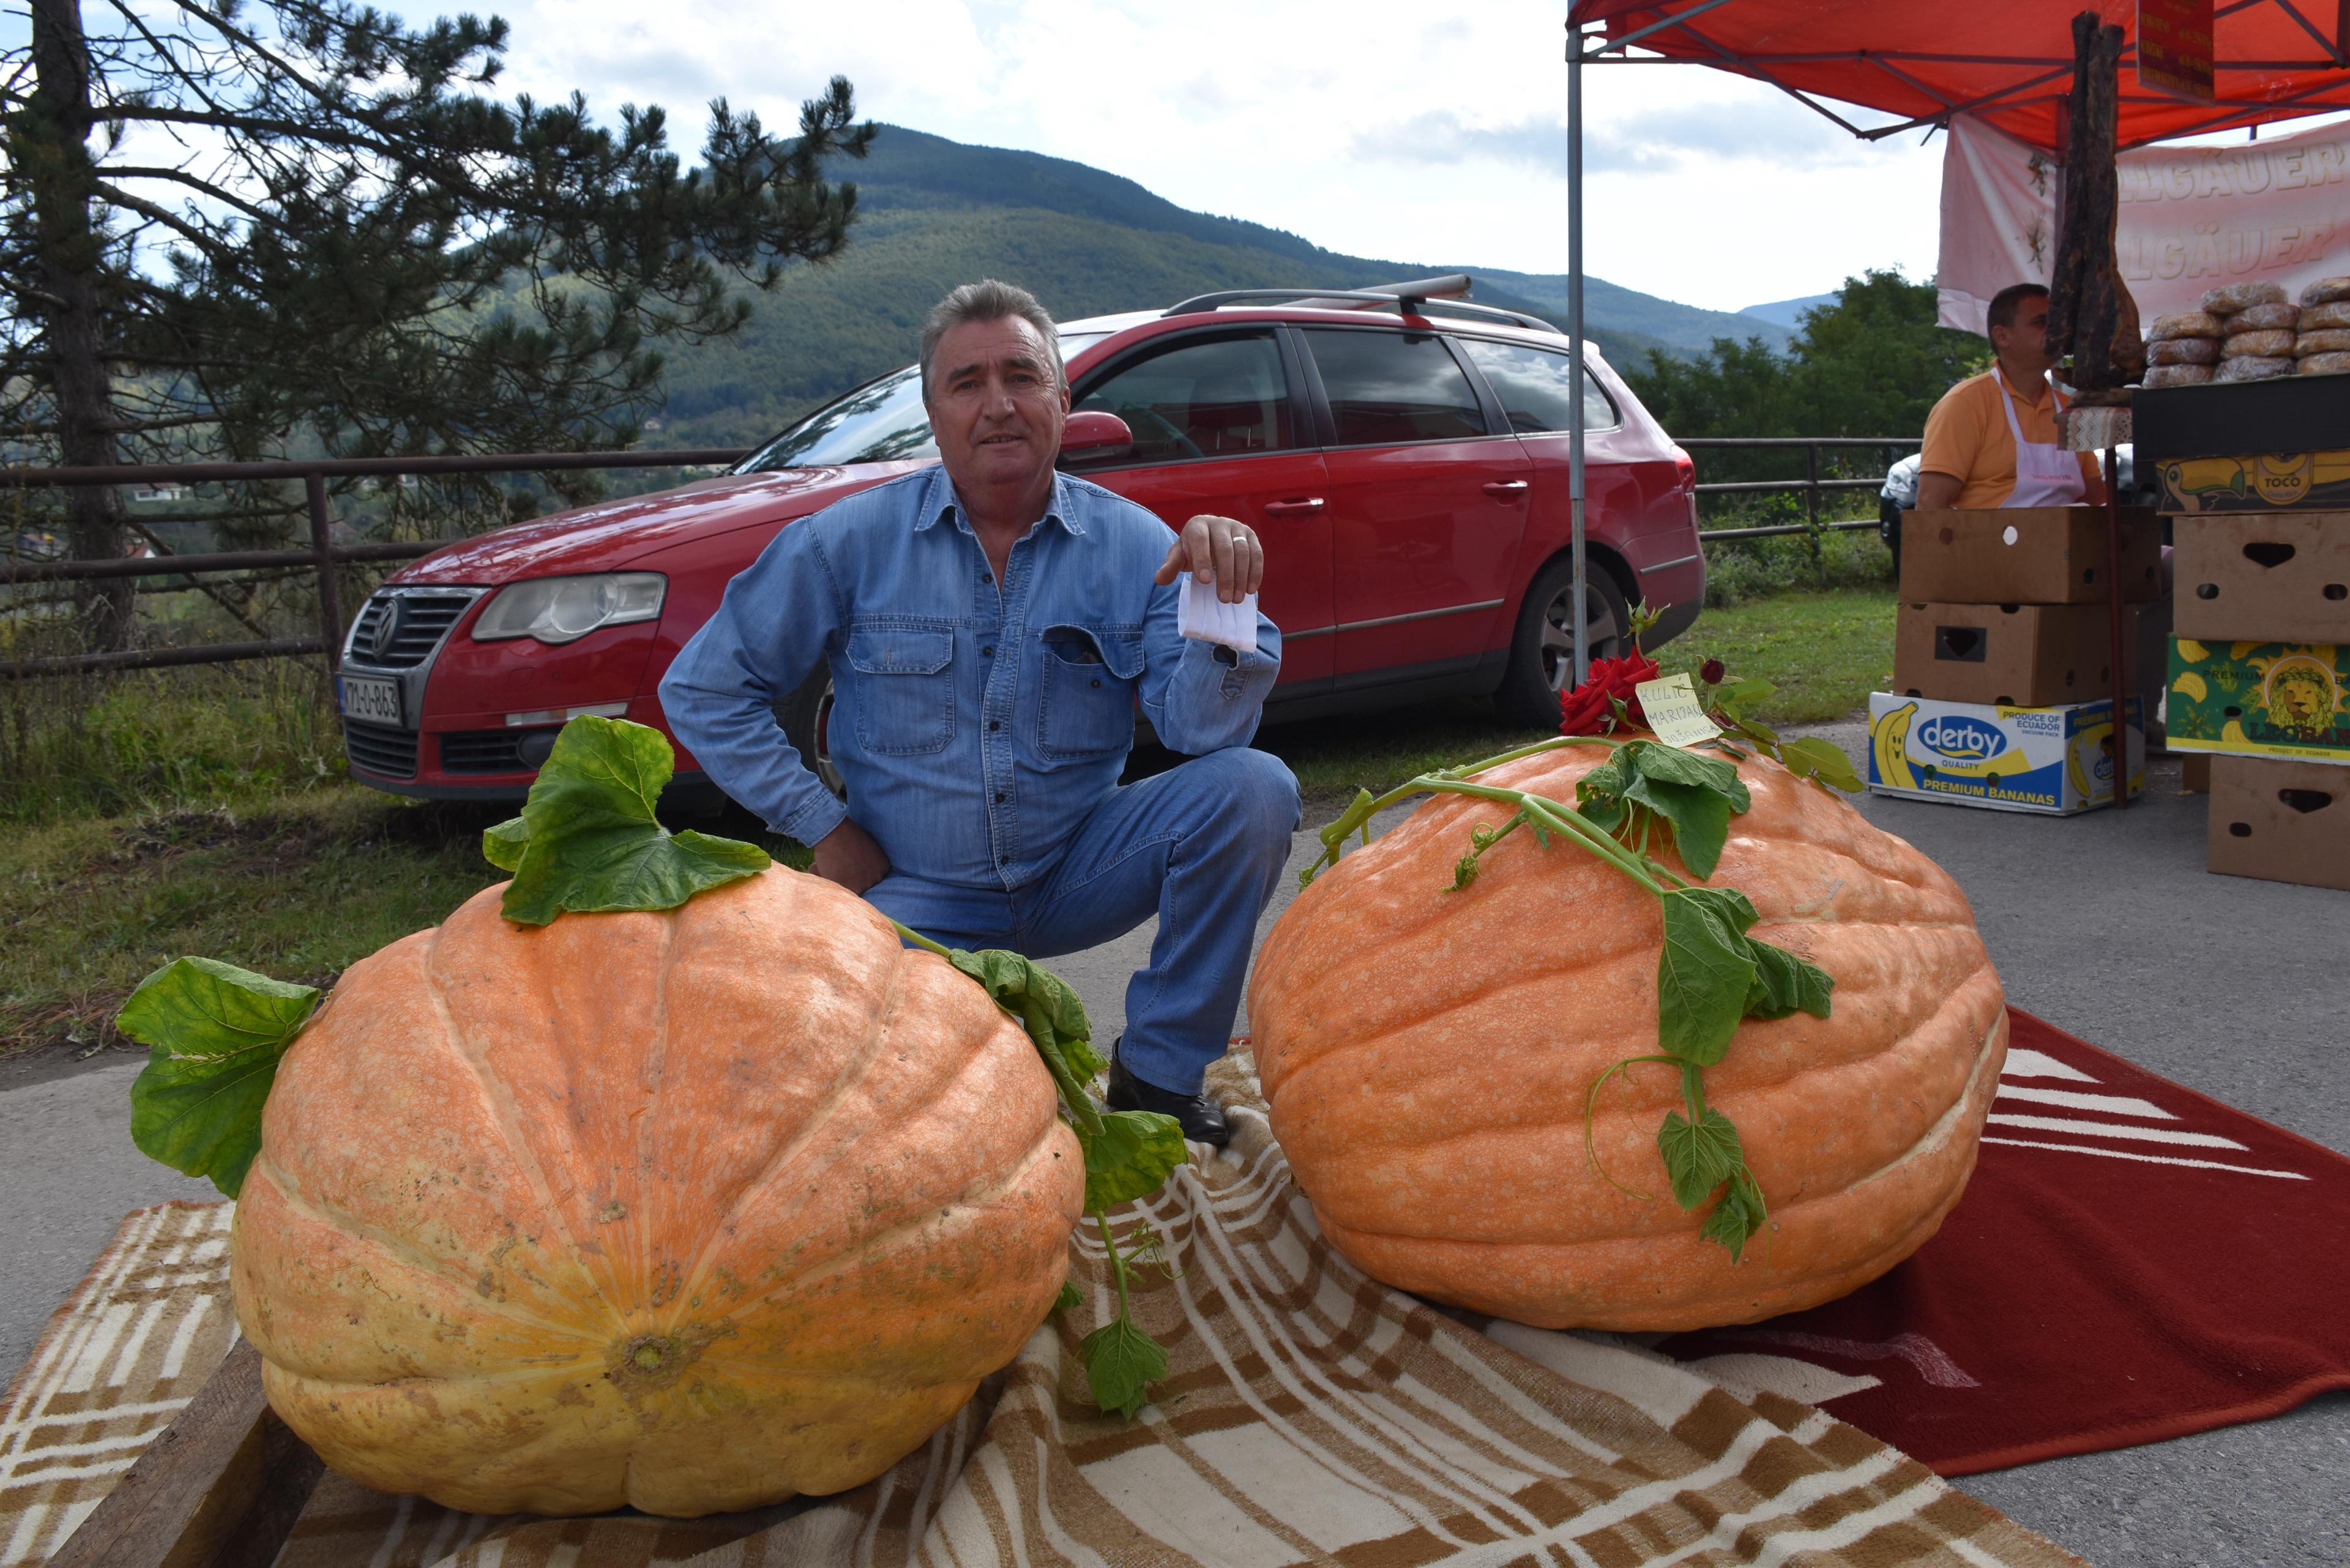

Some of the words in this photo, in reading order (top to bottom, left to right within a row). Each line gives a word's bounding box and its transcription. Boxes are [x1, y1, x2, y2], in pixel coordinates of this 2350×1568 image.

[2264, 477, 2300, 488] TOCO
[2203, 670, 2265, 681] PREMIUM
[2003, 711, 2045, 722] PRODUCE
[2016, 720, 2060, 731] ECUADOR
[1923, 717, 2000, 759] derby
[1942, 760, 1979, 771] QUALITY
[1923, 779, 1985, 796] PREMIUM
[1988, 788, 2055, 806] BANANAS
